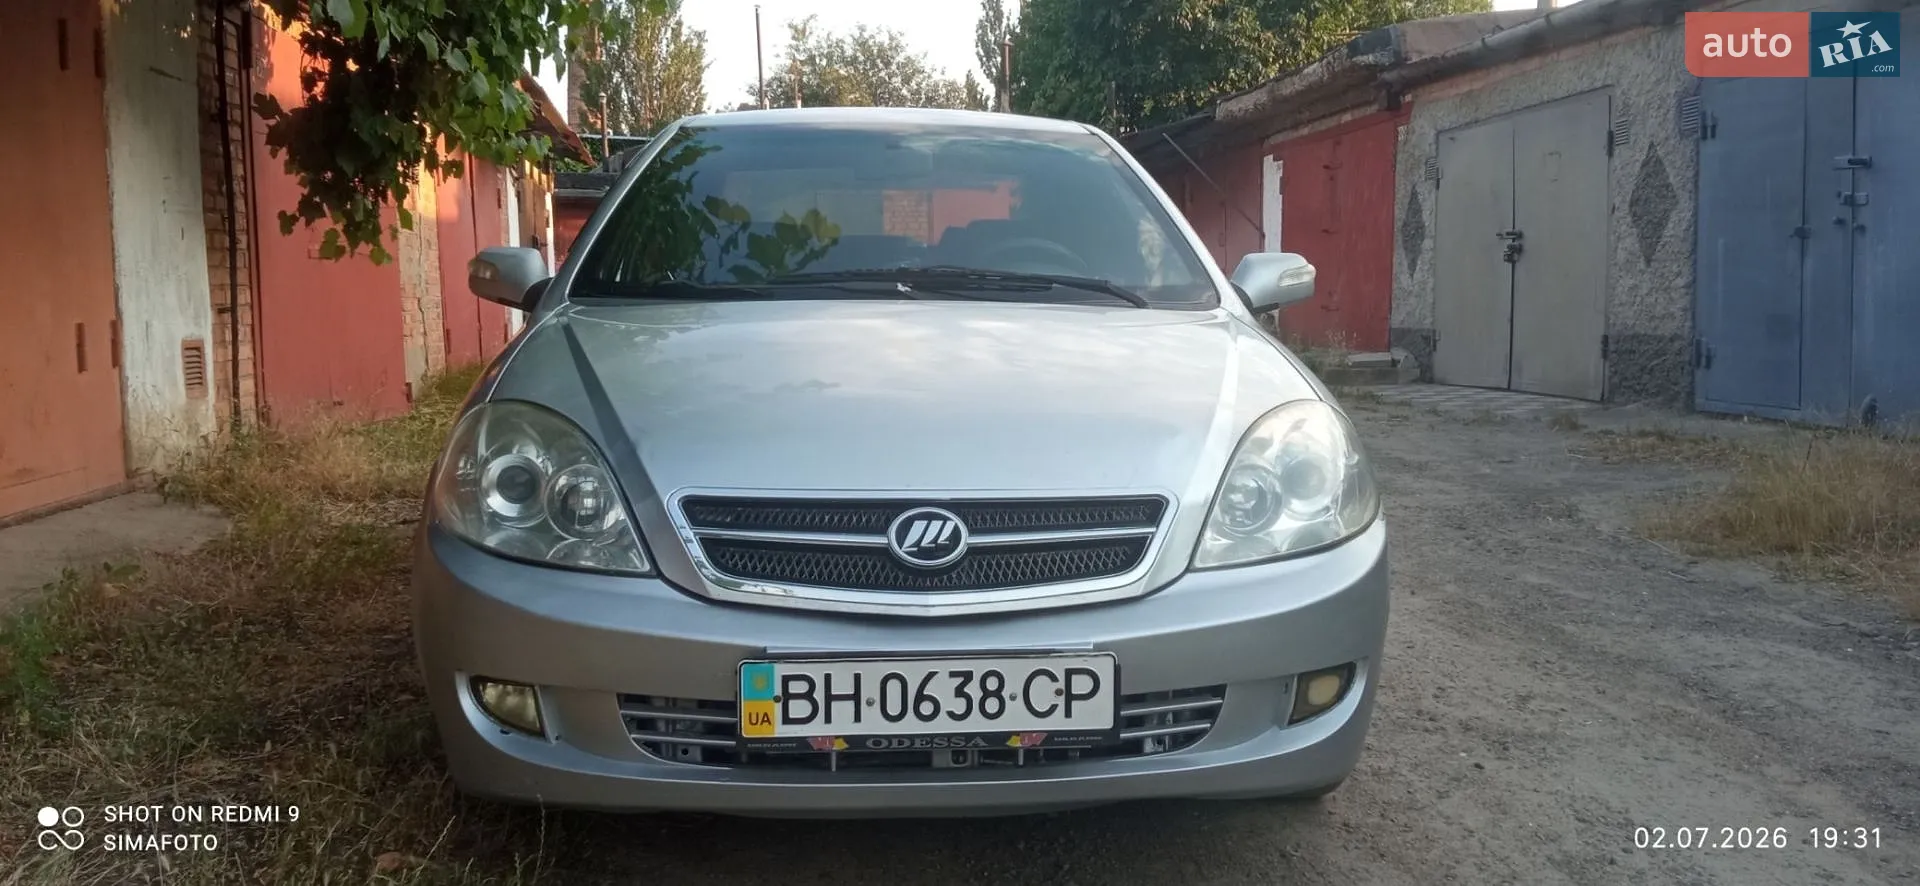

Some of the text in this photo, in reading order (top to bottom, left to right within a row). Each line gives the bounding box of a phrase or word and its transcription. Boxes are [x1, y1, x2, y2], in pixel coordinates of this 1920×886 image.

[781, 667, 1101, 725] BH 0638 CP
[748, 712, 772, 726] UA
[865, 735, 988, 749] ODESSA
